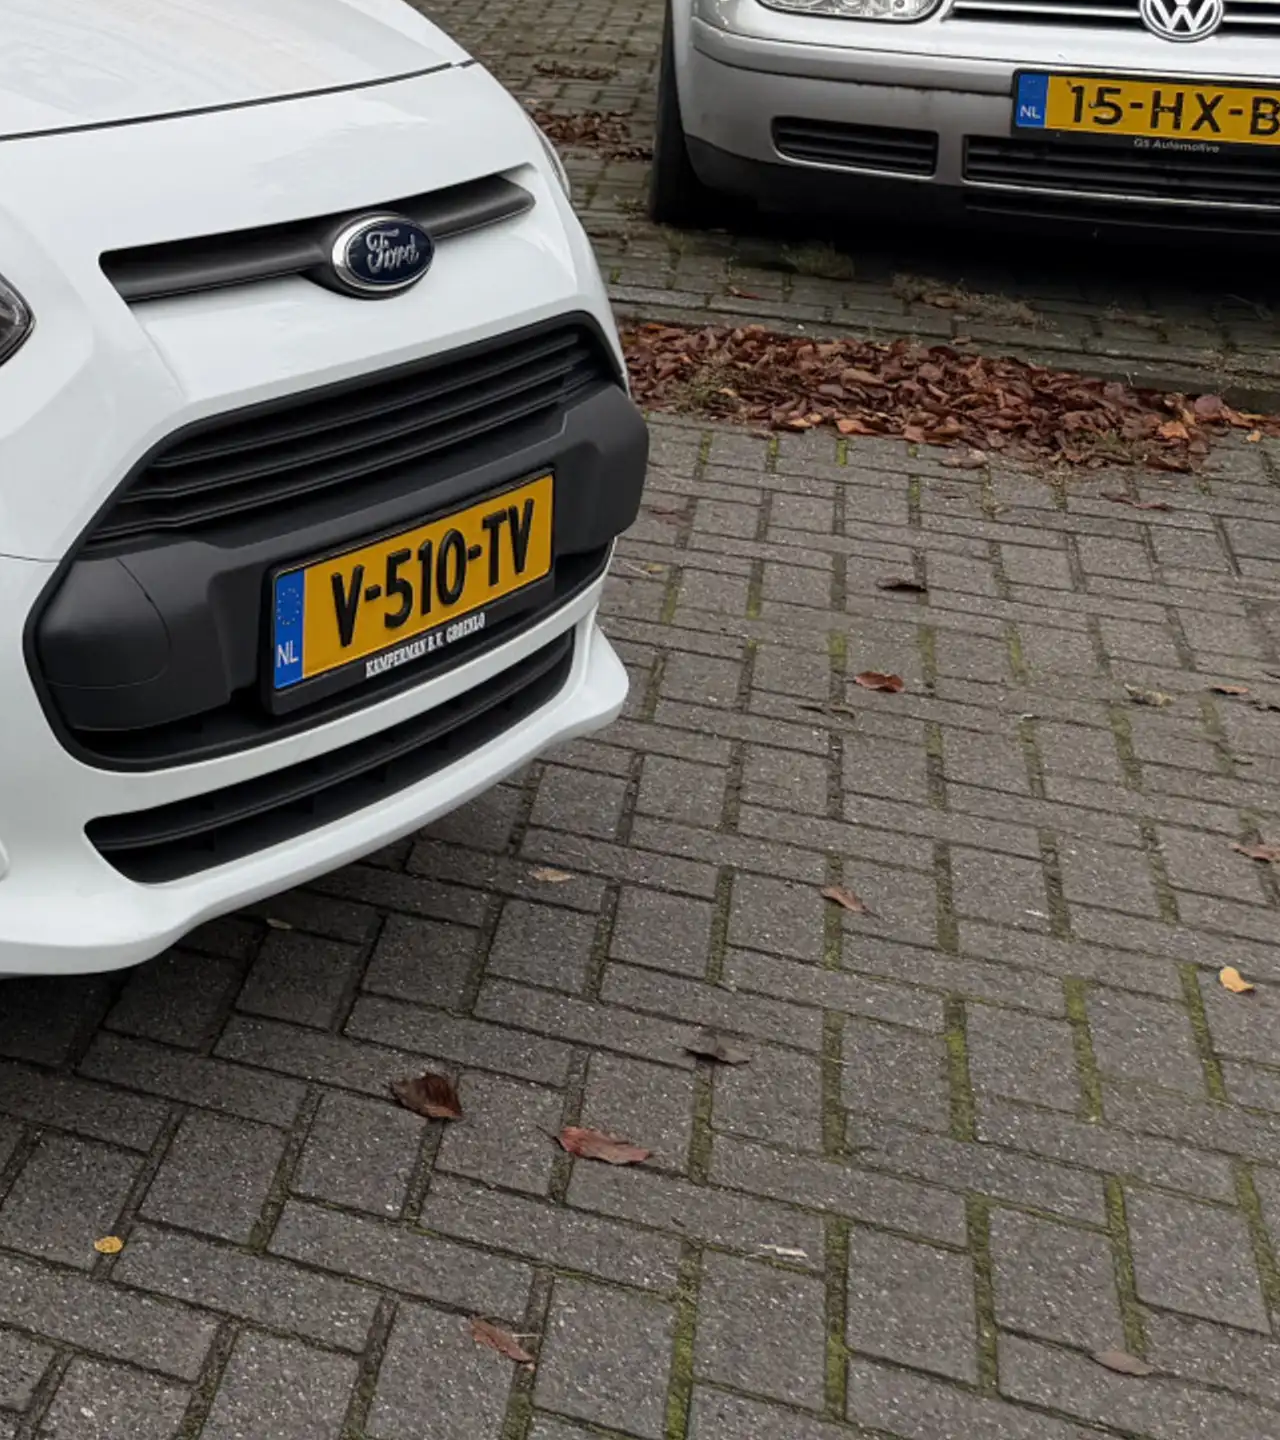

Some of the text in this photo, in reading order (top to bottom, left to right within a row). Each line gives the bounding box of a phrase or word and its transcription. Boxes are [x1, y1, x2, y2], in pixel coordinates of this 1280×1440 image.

[1020, 105, 1041, 119] NL
[1152, 140, 1220, 153] Automotive
[366, 228, 420, 274] Ford
[330, 497, 536, 648] V-510-TV
[276, 640, 300, 669] NL
